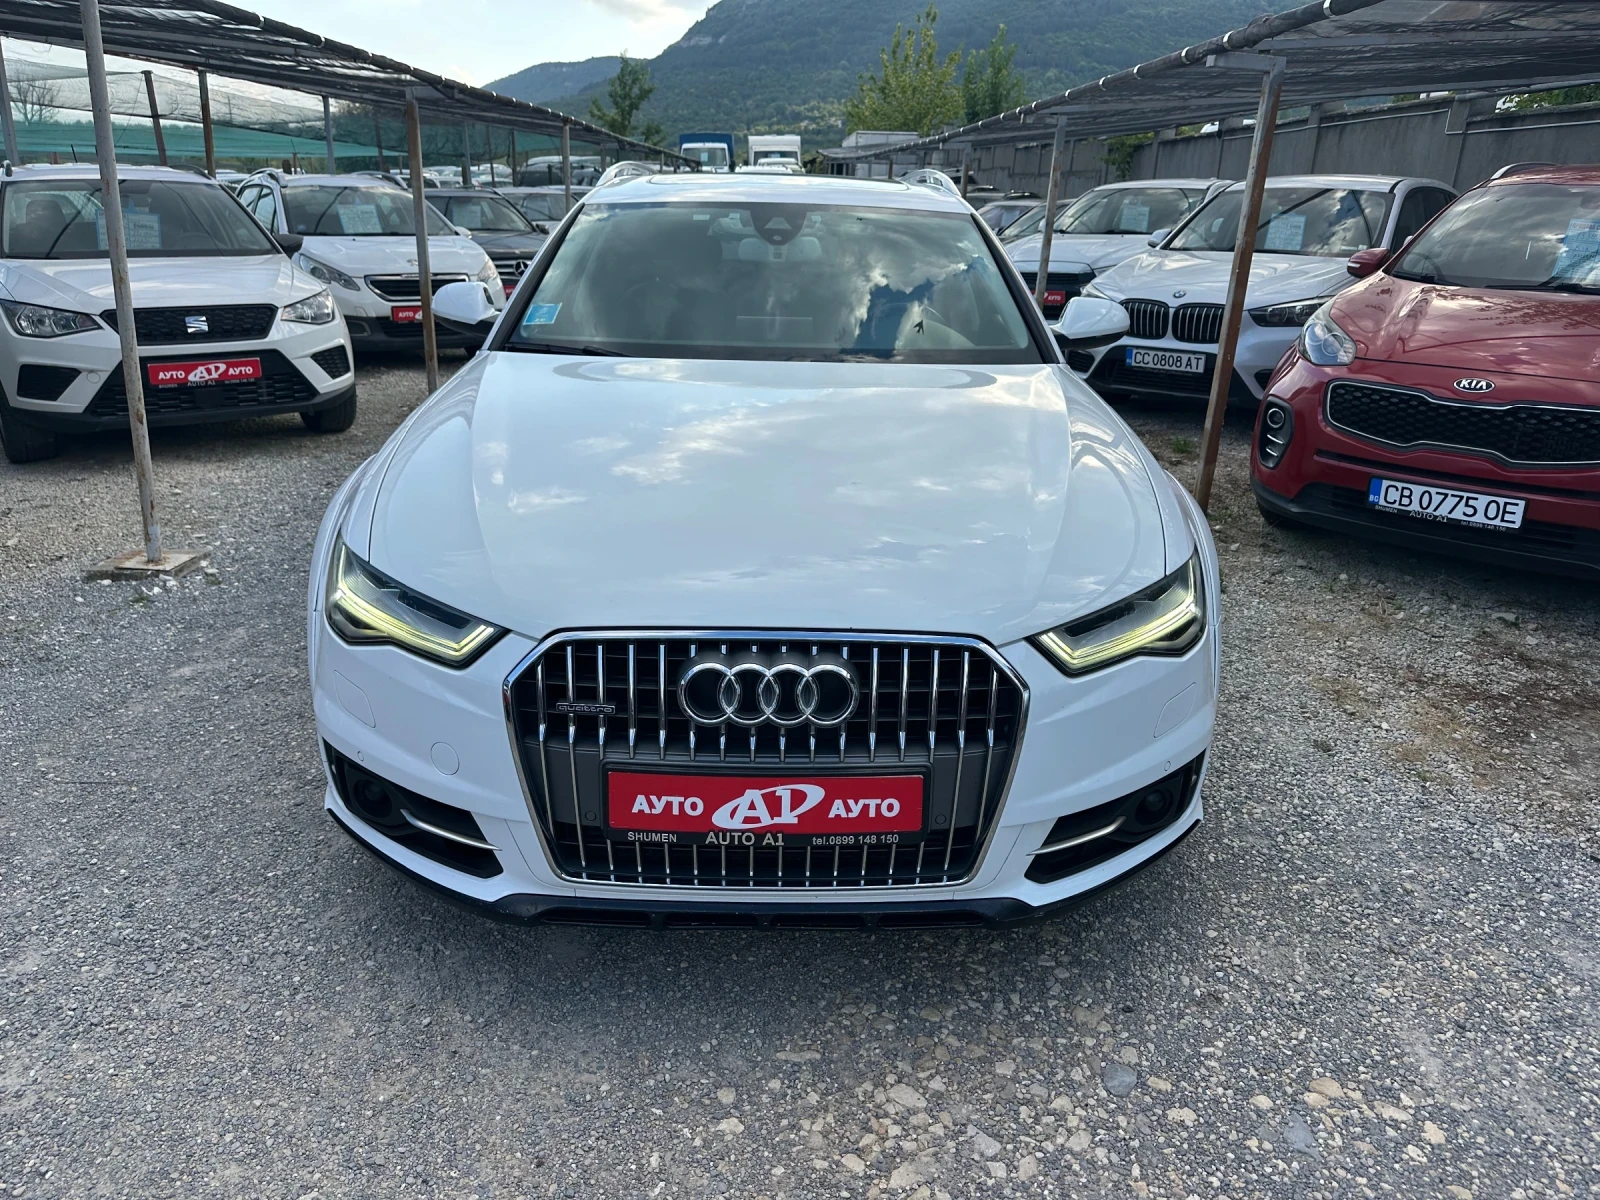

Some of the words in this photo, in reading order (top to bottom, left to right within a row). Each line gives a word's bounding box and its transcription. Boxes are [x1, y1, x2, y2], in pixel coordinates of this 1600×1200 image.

[1134, 351, 1150, 365] CC
[1152, 353, 1182, 369] 0808
[1184, 356, 1203, 371] AT
[1459, 379, 1487, 390] KIA
[1383, 484, 1413, 508] CB
[1418, 490, 1479, 518] 0775
[1409, 510, 1434, 520] AUTO
[1436, 515, 1448, 523] A1
[558, 705, 613, 713] quattro
[627, 831, 677, 843] SHUMEN
[705, 831, 755, 846] AUTO
[762, 833, 785, 846] A1
[812, 834, 855, 846] tel.0899
[857, 834, 877, 845] 148
[880, 833, 899, 844] 150
